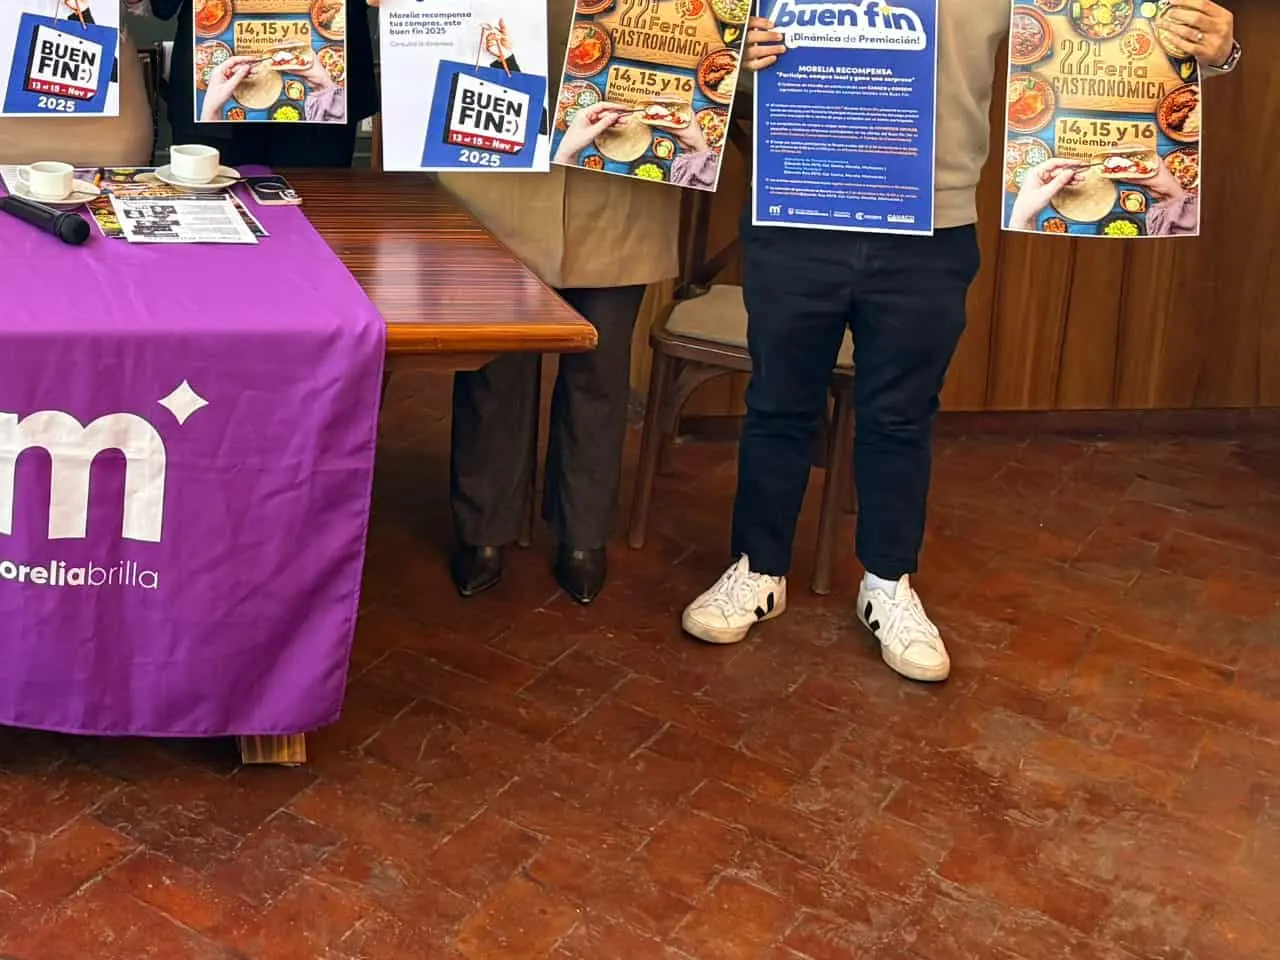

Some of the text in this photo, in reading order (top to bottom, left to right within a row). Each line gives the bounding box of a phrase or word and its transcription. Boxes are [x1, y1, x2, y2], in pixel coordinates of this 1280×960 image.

[775, 1, 916, 32] buen fin
[281, 25, 290, 37] y
[292, 23, 309, 35] 16
[649, 16, 698, 37] Feria
[237, 36, 281, 44] Noviembre
[611, 28, 708, 57] GASTRONÓMICA
[843, 34, 856, 43] de
[859, 35, 920, 44] Premiación!
[41, 40, 96, 66] BUEN
[799, 65, 892, 75] MORELIA RECOMPENSA
[1094, 60, 1148, 78] Feria
[609, 82, 660, 96] Noviembre
[661, 79, 671, 91] y
[675, 77, 692, 92] 16
[1053, 77, 1165, 99] GASTRONÓMICA
[38, 96, 75, 112] 2025
[462, 89, 522, 117] BUEN
[1116, 127, 1127, 141] y
[1131, 123, 1154, 139] 16
[1058, 136, 1118, 147] Noviembre
[459, 149, 501, 167] 2025
